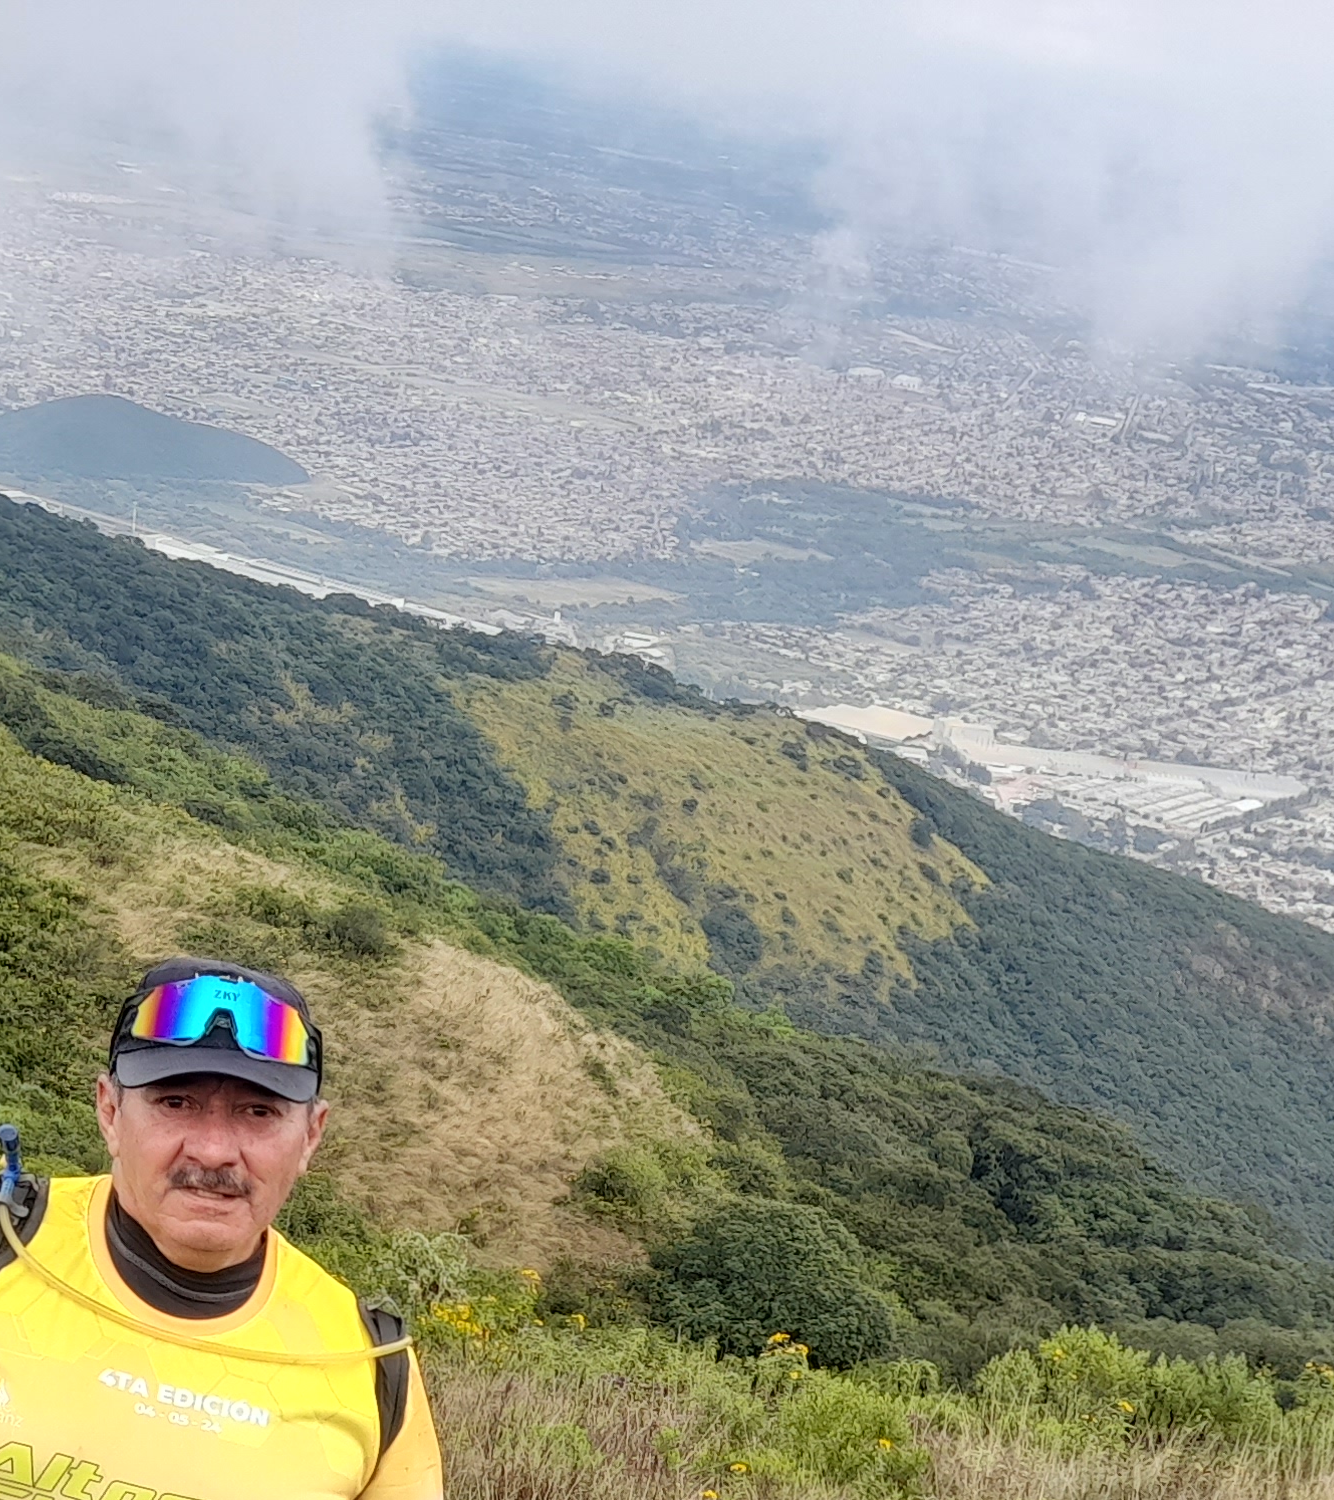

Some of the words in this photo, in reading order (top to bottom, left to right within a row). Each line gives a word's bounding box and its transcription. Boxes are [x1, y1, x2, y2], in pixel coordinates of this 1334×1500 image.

[213, 989, 240, 1002] ZKY
[98, 1367, 149, 1398] 4TA
[157, 1383, 270, 1428] EDICIÓN
